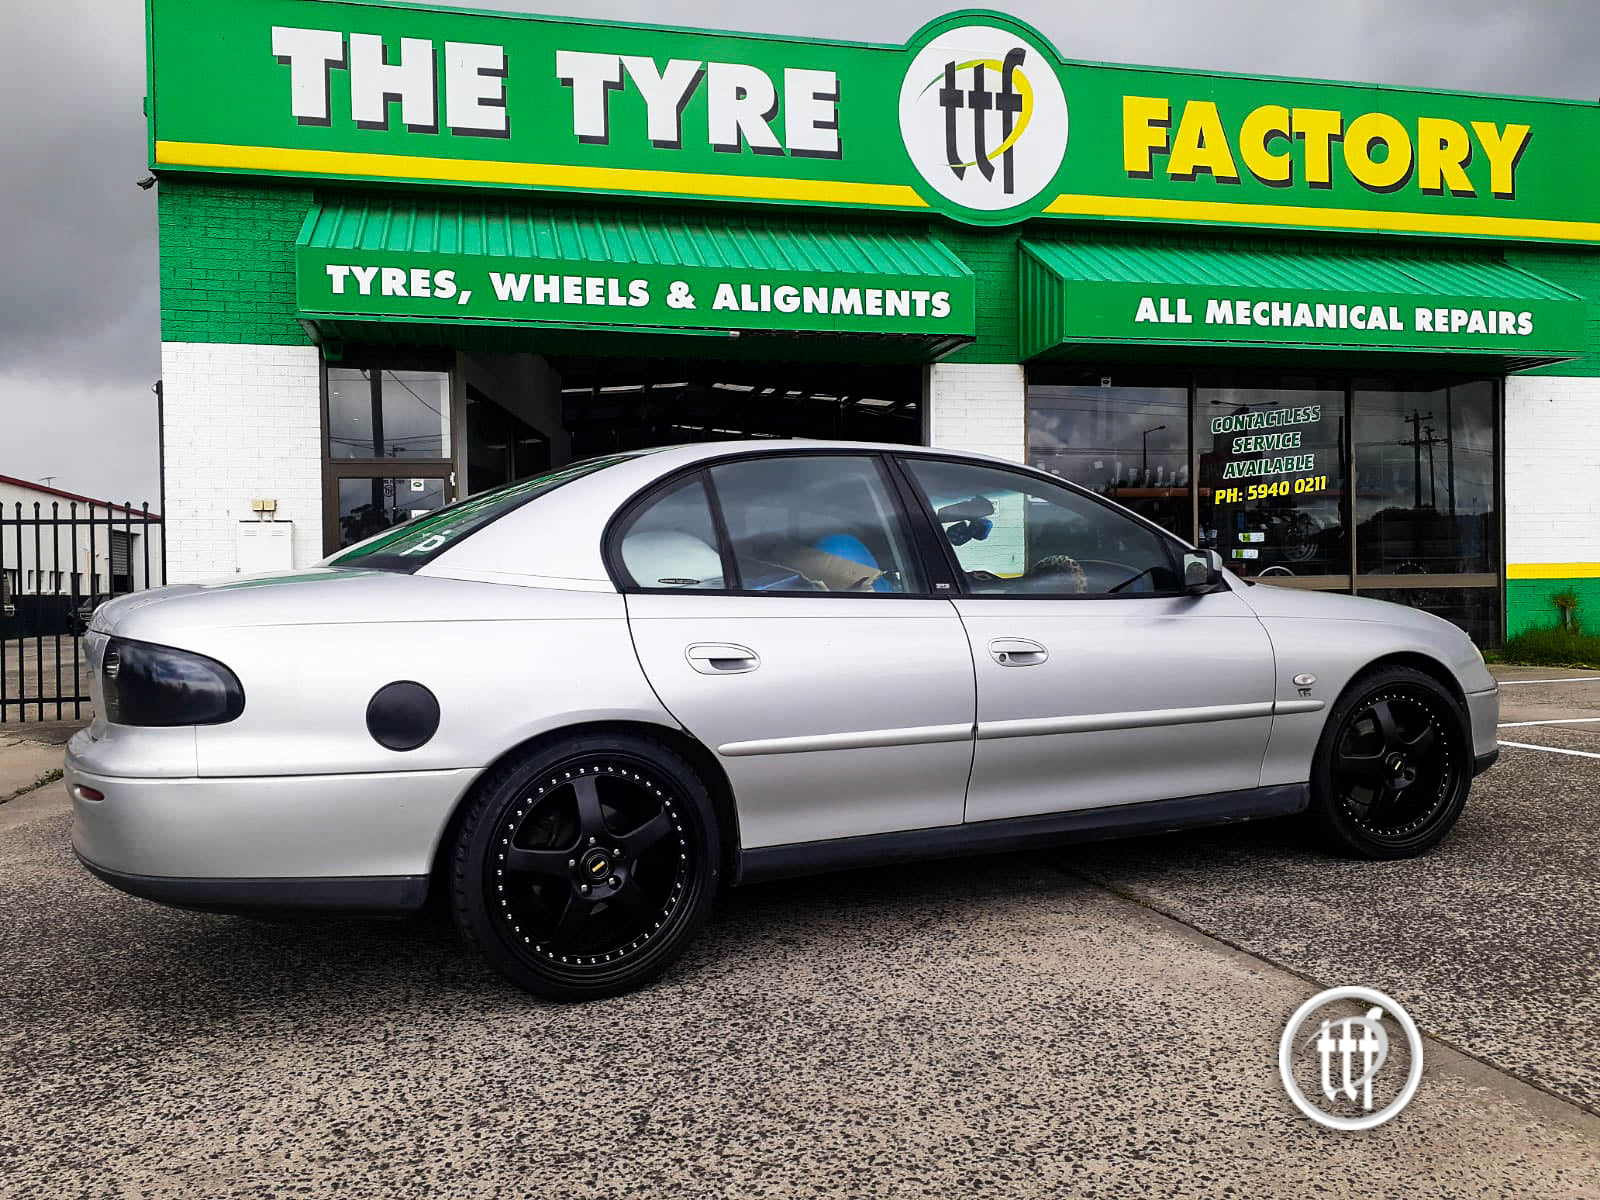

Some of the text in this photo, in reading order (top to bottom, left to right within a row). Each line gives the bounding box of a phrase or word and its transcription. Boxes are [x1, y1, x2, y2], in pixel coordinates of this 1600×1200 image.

[271, 25, 1531, 198] THE TYRE FACTORY
[325, 264, 952, 318] TYRES, WHEELS & ALIGNMENTS
[1134, 297, 1534, 336] ALL MECHANICAL REPAIRS
[1211, 405, 1320, 433] CONTACTLESS
[1232, 432, 1301, 453] SERVICE
[1223, 454, 1314, 479] AVAILABLE
[1214, 475, 1328, 505] PH: 5940 0211
